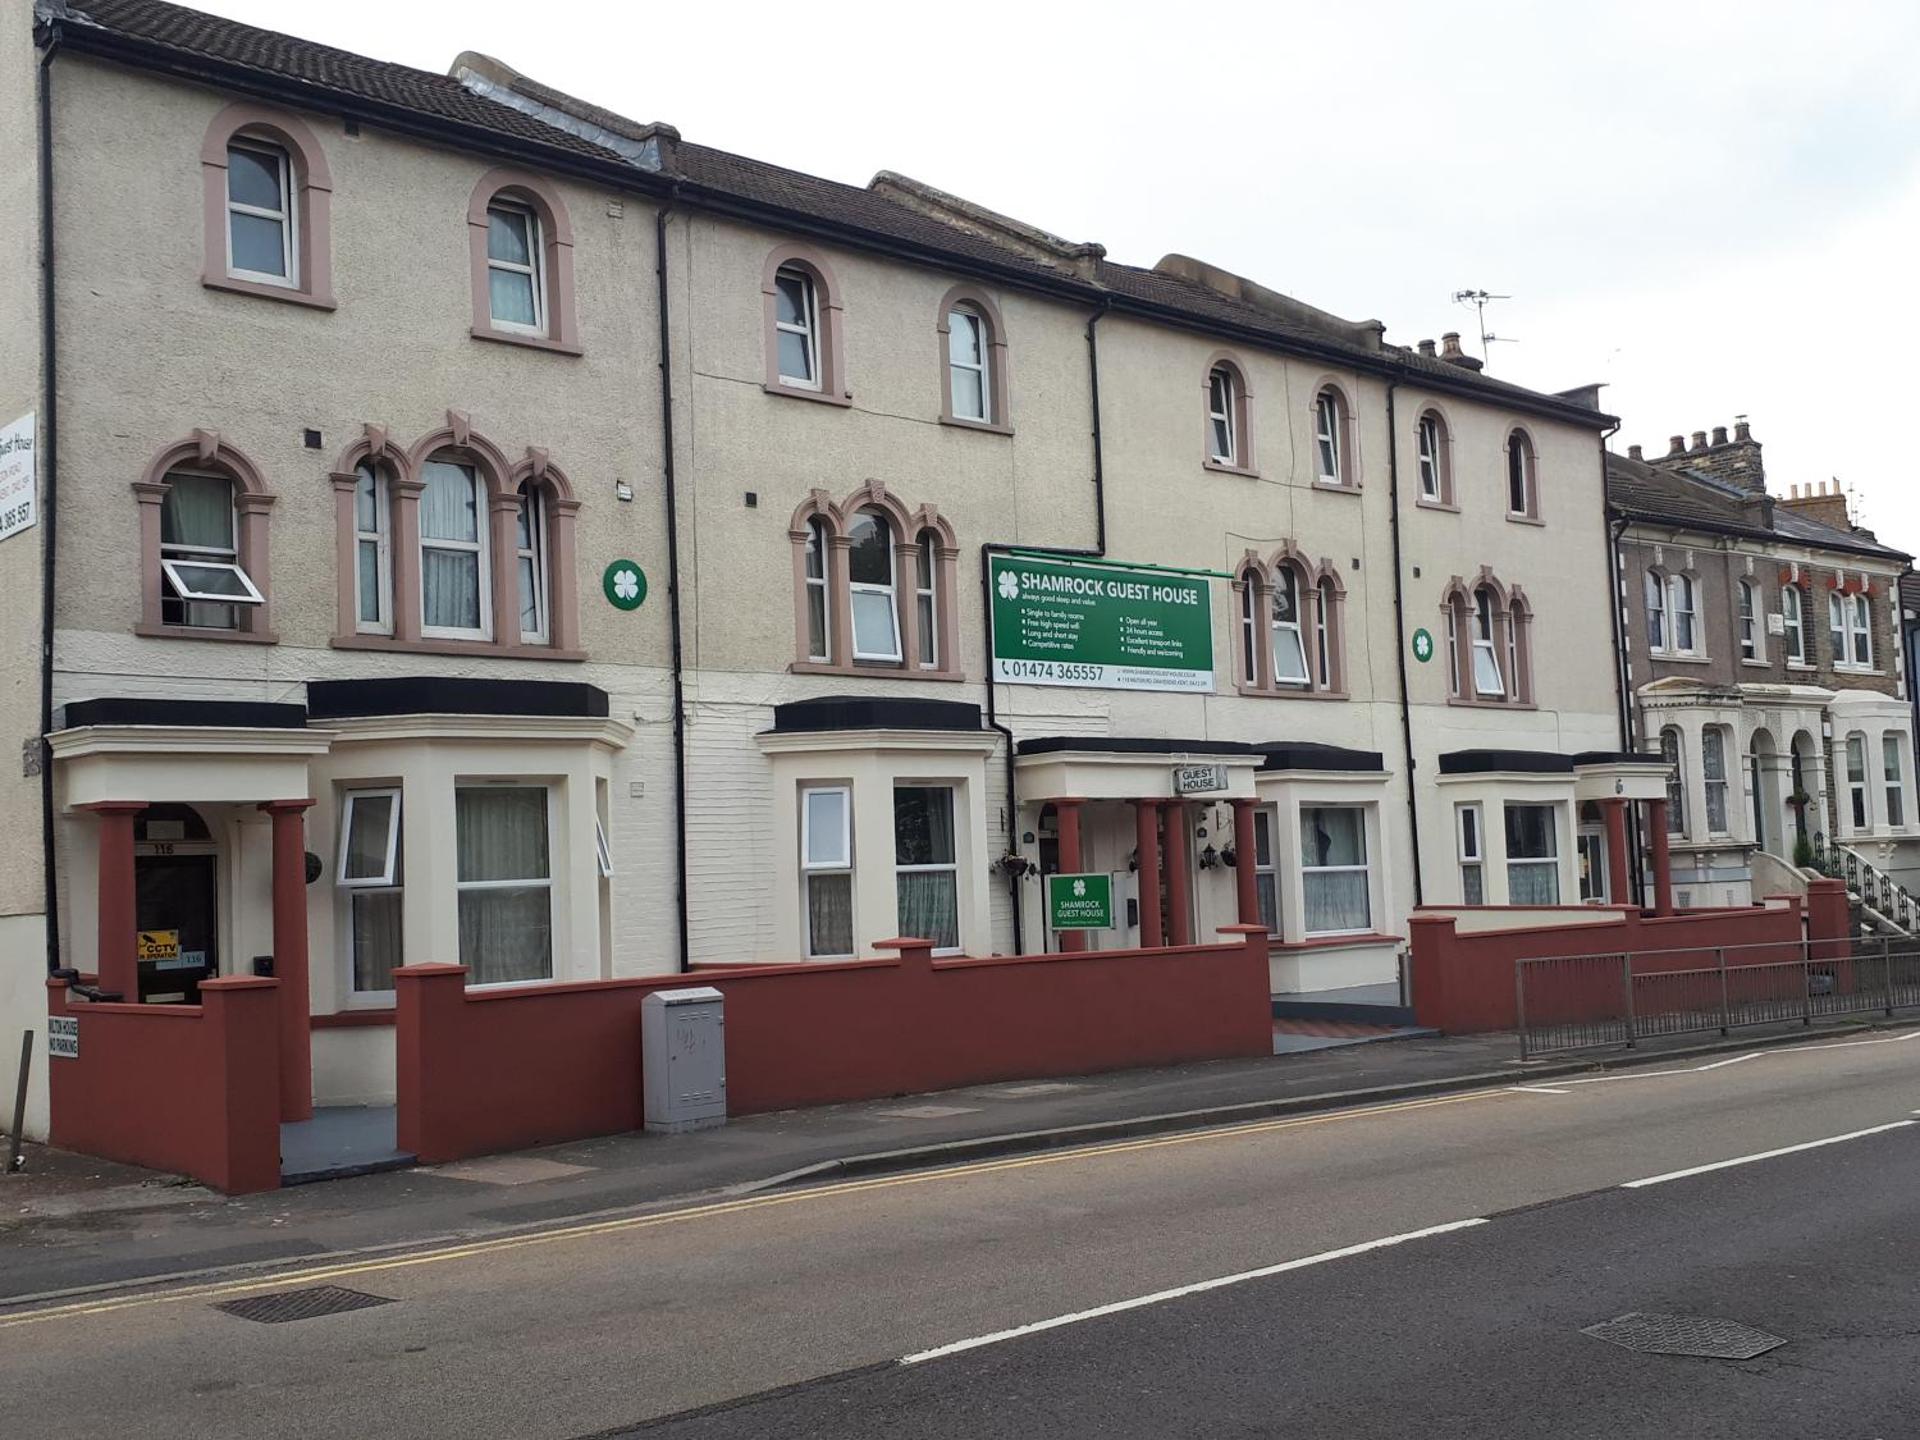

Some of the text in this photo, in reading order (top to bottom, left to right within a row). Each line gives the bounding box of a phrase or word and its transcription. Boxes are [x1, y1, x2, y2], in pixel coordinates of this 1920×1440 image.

[17, 502, 31, 524] 557
[1021, 572, 1198, 605] SHAMROCK GUEST HOUSE
[1041, 594, 1056, 603] good
[1056, 595, 1071, 604] sleep
[1071, 597, 1081, 605] and
[1026, 608, 1043, 618] Single
[1051, 610, 1067, 620] family
[1027, 618, 1039, 626] Free
[1040, 619, 1052, 629] high
[1053, 622, 1070, 630] speed
[1126, 616, 1139, 625] Open
[1027, 628, 1079, 641] Long and short stay
[1126, 626, 1133, 634] 24
[1134, 627, 1147, 635] hours
[1027, 639, 1075, 650] Competitive rates
[1126, 636, 1148, 645] Excellent
[1149, 638, 1170, 647] transport
[1127, 646, 1146, 656] Friendly
[1157, 649, 1184, 659] welcoming
[1013, 661, 1053, 678] 01474
[1057, 663, 1104, 681] 365557
[1183, 767, 1213, 780] GUEST
[1183, 778, 1215, 790] HOUSE
[1060, 900, 1101, 909] SHAMROCK
[1057, 909, 1104, 918] GUEST HOUSE
[147, 943, 176, 953] CCTV
[146, 952, 177, 960] OPERATION
